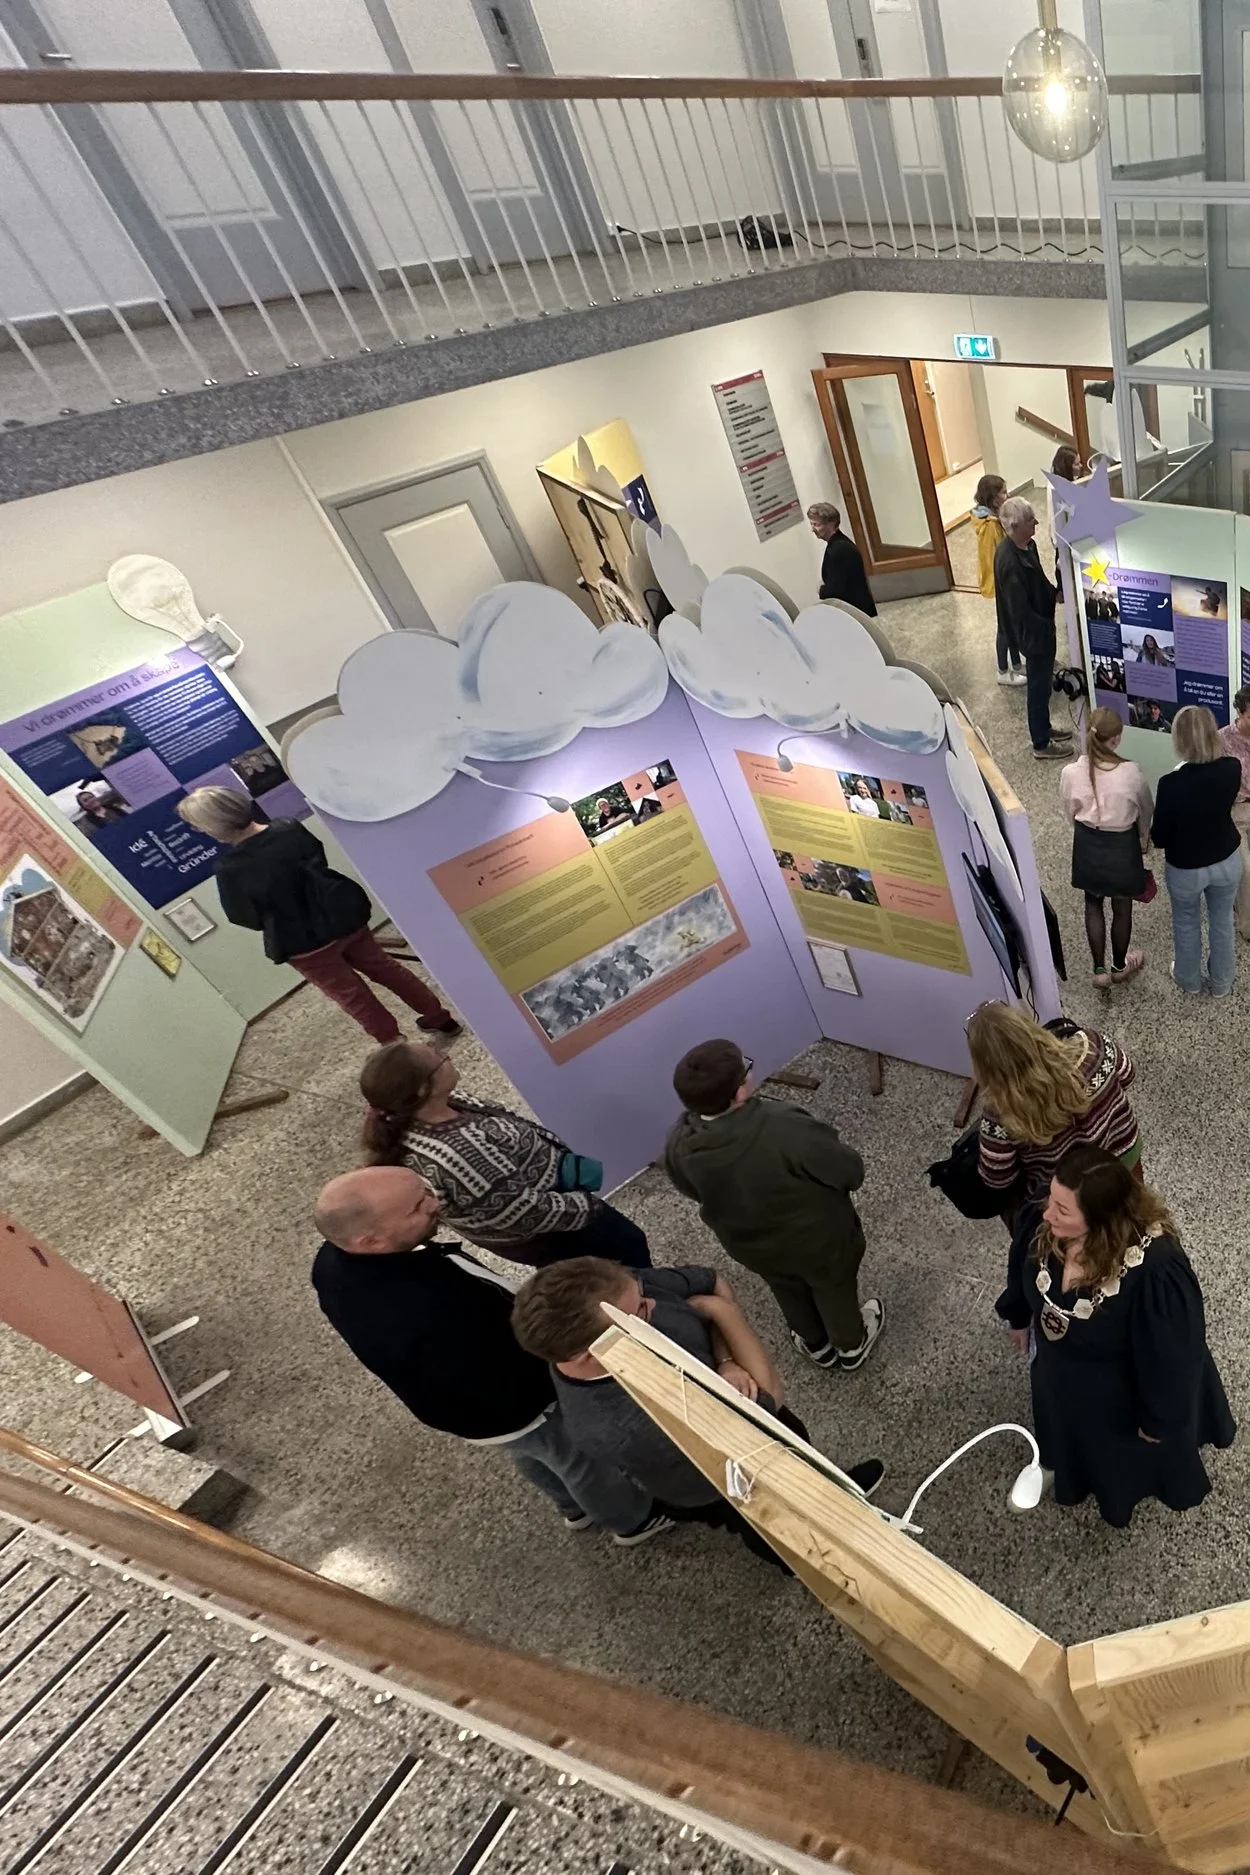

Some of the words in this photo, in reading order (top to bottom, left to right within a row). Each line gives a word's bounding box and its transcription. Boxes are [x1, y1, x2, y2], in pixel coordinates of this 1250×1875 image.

[24, 719, 41, 732] Vi
[41, 692, 105, 727] drømmer
[108, 681, 131, 697] om
[130, 674, 141, 688] å
[128, 838, 148, 853] Idé
[178, 846, 219, 873] Gründer
